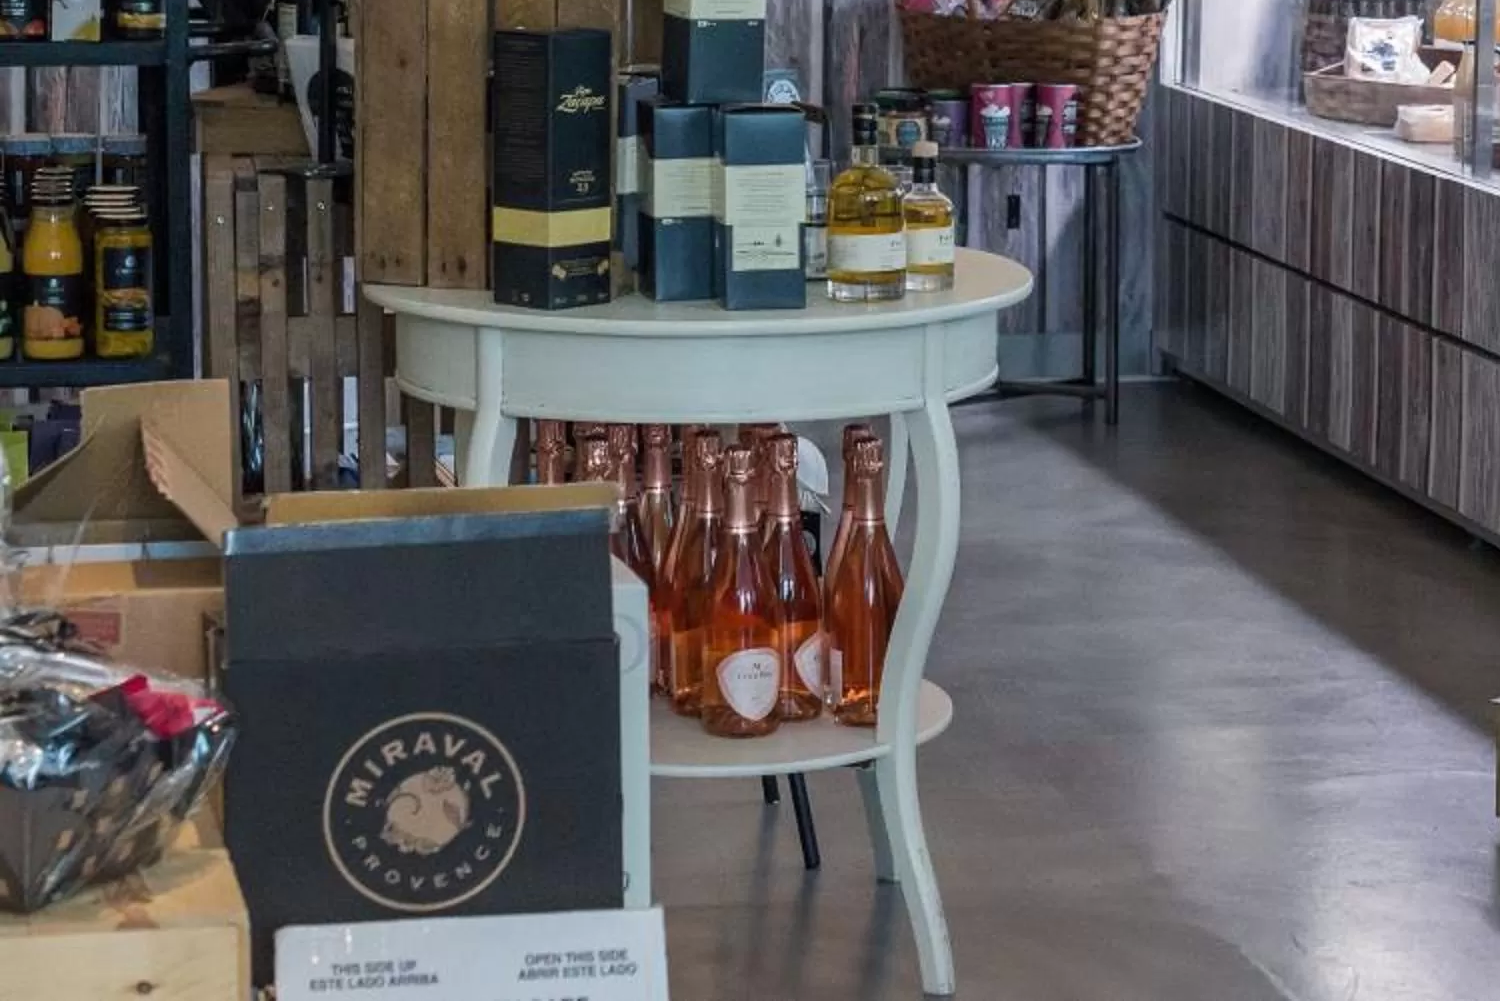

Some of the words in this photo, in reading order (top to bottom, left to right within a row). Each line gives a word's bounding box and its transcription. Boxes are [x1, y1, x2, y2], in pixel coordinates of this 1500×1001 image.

[345, 731, 502, 808] MIRAVAL
[352, 823, 502, 890] PROVENCE
[524, 952, 562, 966] OPEN
[566, 950, 595, 964] THIS
[598, 948, 628, 962] SIDE
[331, 963, 361, 976] THIS
[364, 960, 394, 974] SIDE
[398, 959, 417, 972] UP
[518, 966, 559, 981] ABRIR
[562, 965, 596, 979] ESTE
[599, 962, 637, 977] LADO
[309, 978, 343, 991] ESTE
[347, 976, 384, 990] LADO
[388, 973, 439, 987] ARRIBA
